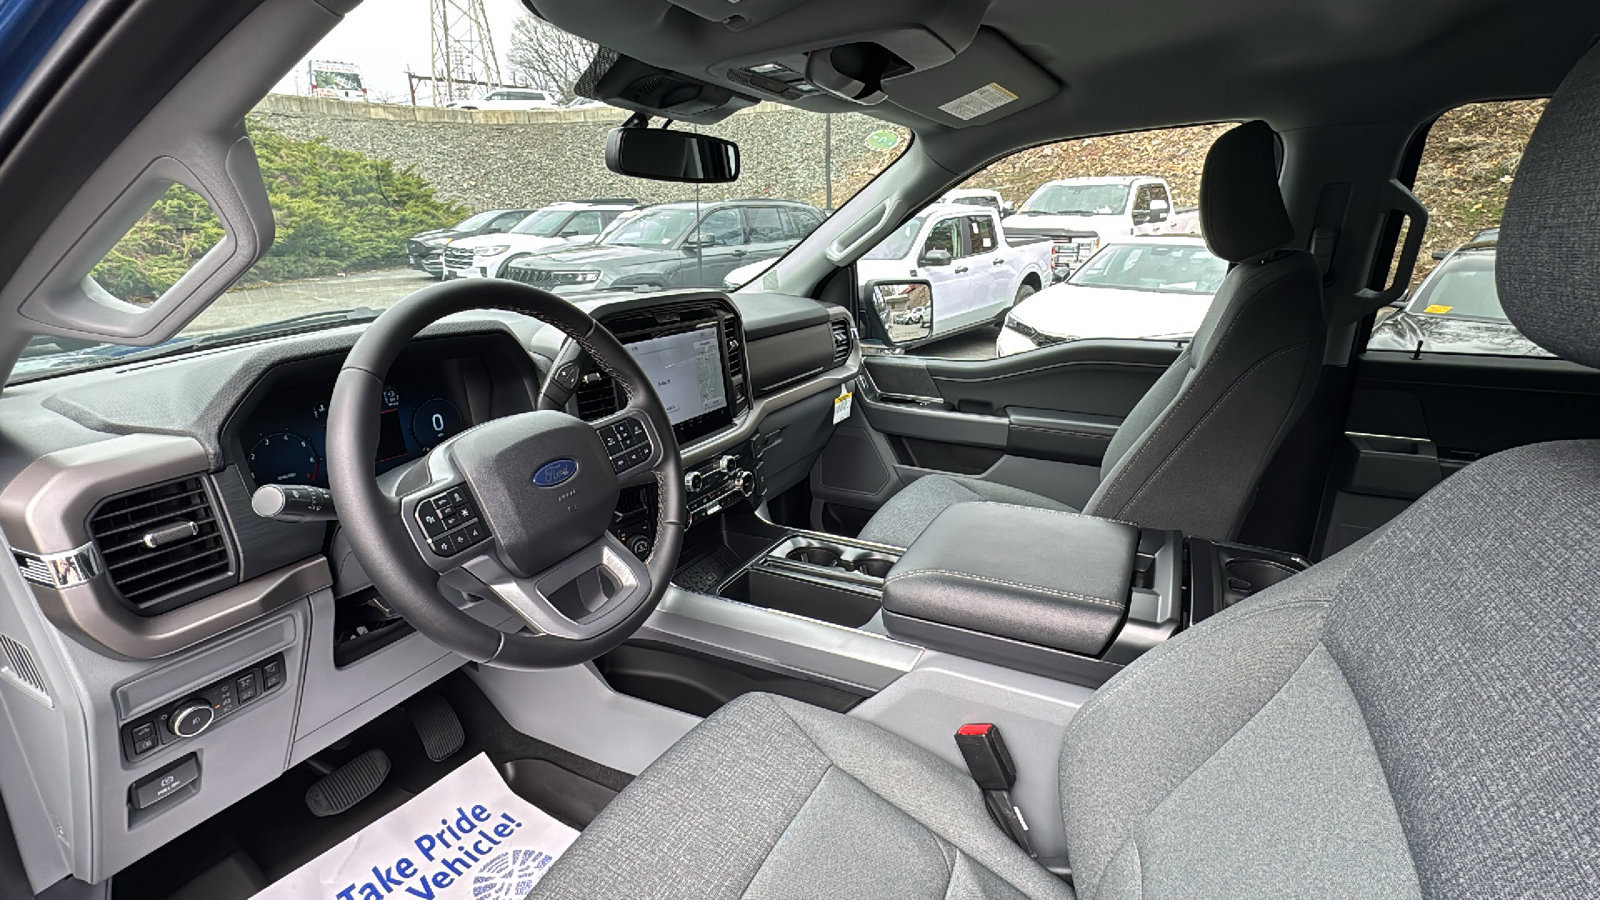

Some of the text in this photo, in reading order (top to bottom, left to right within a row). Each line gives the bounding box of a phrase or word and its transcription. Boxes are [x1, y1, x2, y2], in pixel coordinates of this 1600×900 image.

[432, 413, 444, 431] 0
[335, 857, 419, 900] Take
[414, 804, 492, 862] Pride
[405, 812, 523, 900] Vehicle!
